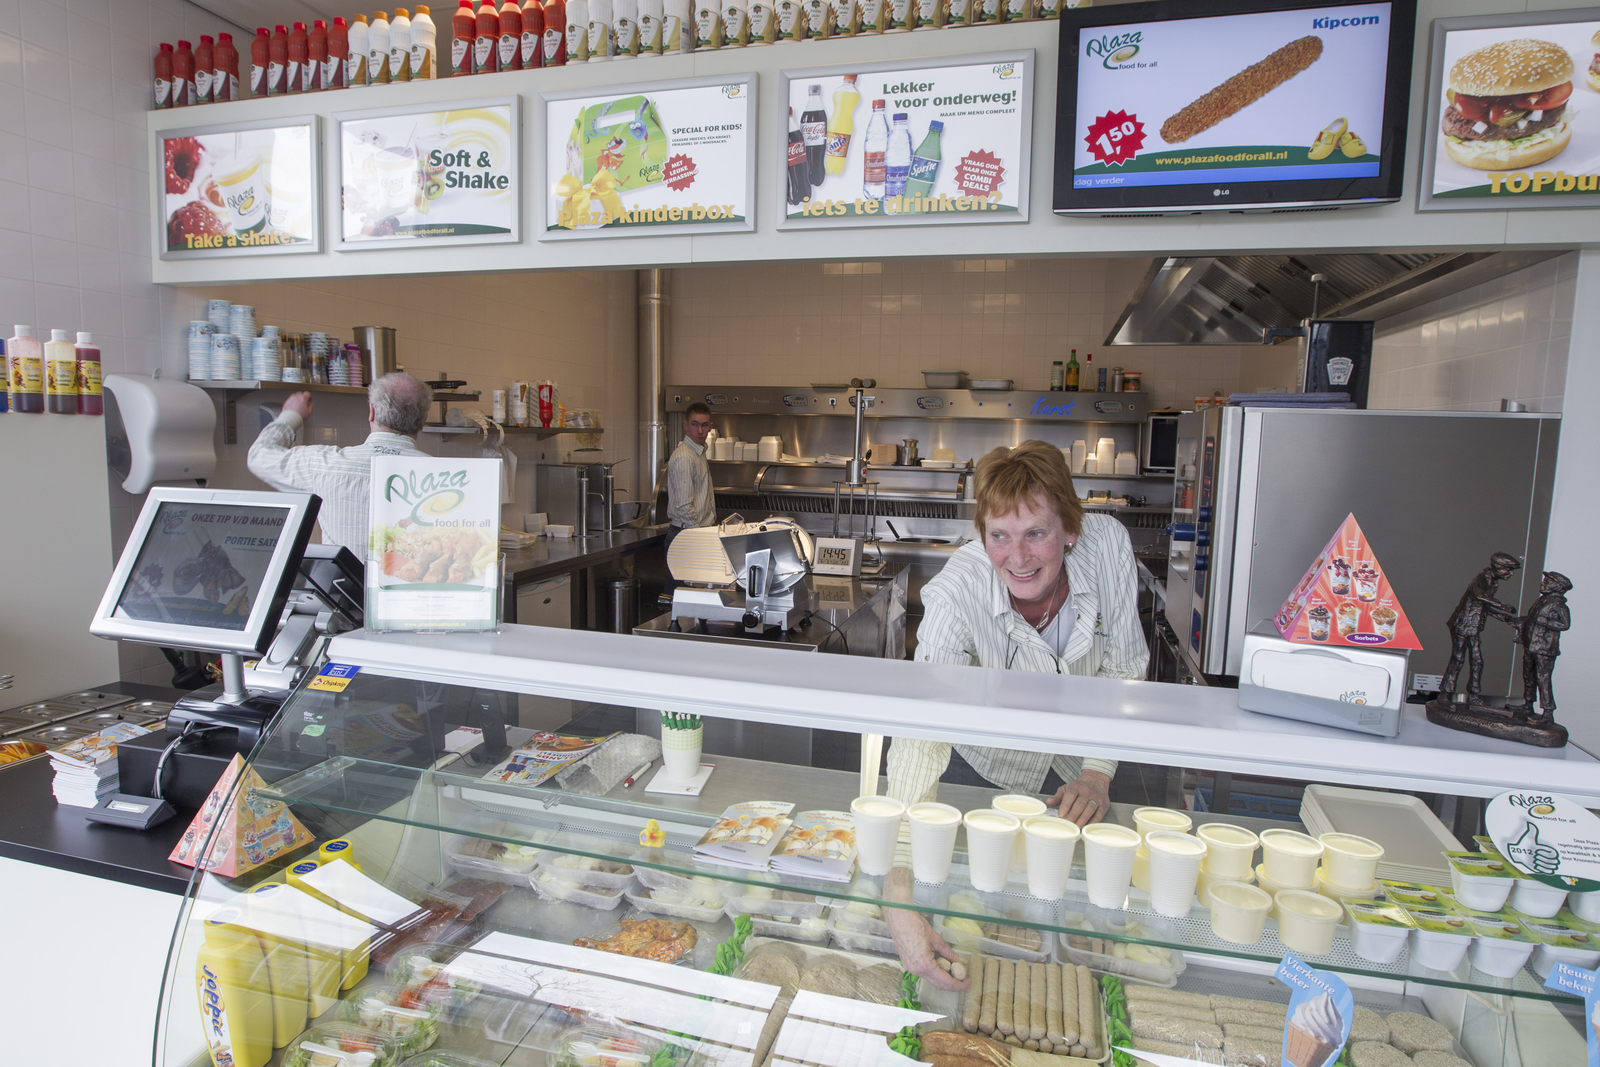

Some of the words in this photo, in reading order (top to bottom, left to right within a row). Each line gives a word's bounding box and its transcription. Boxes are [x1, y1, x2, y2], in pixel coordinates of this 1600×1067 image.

[1313, 15, 1380, 30] Kipcorn
[1086, 31, 1144, 58] Plaza
[883, 80, 934, 94] Lekker
[894, 98, 929, 108] voor
[933, 90, 1017, 106] onderweg!
[429, 149, 471, 168] Soft
[477, 150, 491, 167] &
[671, 160, 683, 168] MET
[964, 159, 985, 168] VRAAG
[1155, 152, 1288, 166] www.plazafoodforall.nl
[669, 165, 688, 176] LEUKE
[910, 161, 937, 176] Sprite
[963, 166, 980, 174] NAAR
[445, 170, 509, 190] Shake
[962, 180, 990, 192] DEALS
[964, 173, 992, 184] COMBI
[1096, 176, 1125, 185] verder
[1487, 171, 1600, 193] TOPbu
[227, 186, 254, 210] Plaza
[802, 196, 847, 216] iets
[854, 198, 879, 214] te
[886, 191, 1003, 213] drinken?
[558, 209, 613, 227] Plaza
[619, 203, 735, 224] kinderbox
[185, 233, 223, 248] Take
[226, 234, 237, 246] a
[1030, 396, 1076, 415] Karst
[374, 446, 401, 456] Plaza
[385, 469, 470, 506] Plaza
[191, 513, 215, 523] ONZE
[217, 515, 231, 524] TIP
[233, 516, 249, 525] V/D
[435, 519, 459, 528] food
[462, 519, 476, 528] for
[479, 518, 491, 528] all
[224, 536, 256, 546] PORTIE
[823, 548, 846, 559] 14:45
[1509, 793, 1555, 809] Plaza
[1511, 846, 1534, 856] 2012
[1280, 966, 1310, 991] beker
[1286, 956, 1336, 995] Vierkante
[1558, 964, 1595, 982] Reuze
[1558, 976, 1593, 994] beker
[202, 964, 226, 1038] joppie
